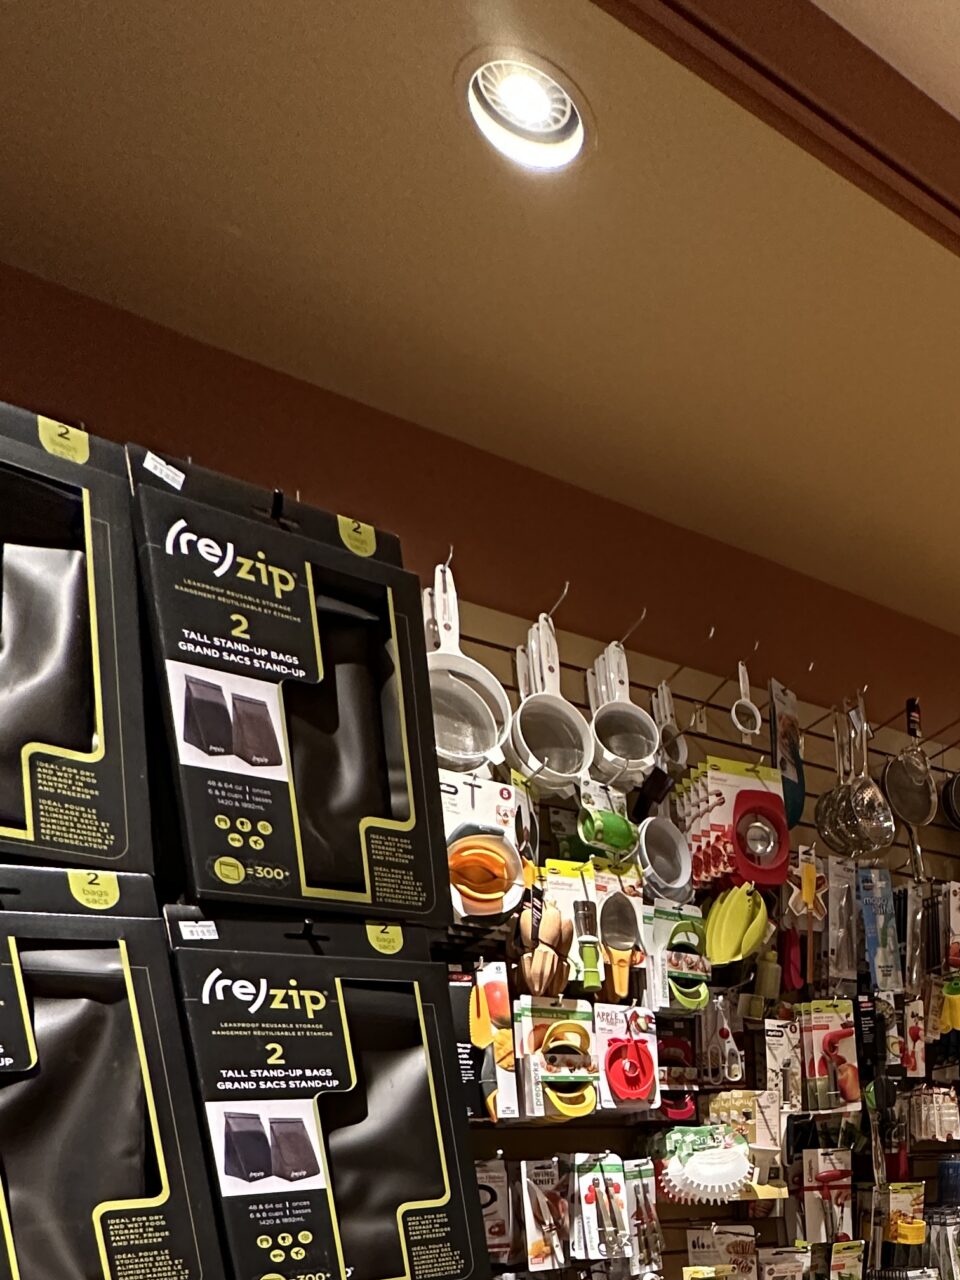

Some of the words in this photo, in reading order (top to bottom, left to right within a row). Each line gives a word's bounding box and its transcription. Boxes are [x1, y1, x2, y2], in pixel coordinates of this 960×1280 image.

[57, 425, 70, 441] 2
[352, 520, 362, 534] 2
[230, 614, 250, 640] 2
[182, 629, 211, 645] TALL
[213, 637, 268, 658] STAND-UP
[270, 651, 300, 666] BAGS
[178, 641, 220, 658] GRAND
[222, 651, 251, 666] SACS
[253, 658, 306, 679] STAND-UP
[86, 872, 100, 886] 2
[82, 888, 109, 898] bags
[380, 923, 390, 934] 2
[265, 1043, 285, 1065] 2
[220, 1070, 248, 1078] TALL
[250, 1069, 303, 1078] STAND-UP
[217, 1081, 256, 1090] GRAND
[259, 1081, 287, 1089] SACS
[288, 1080, 339, 1089] STAND-UP
